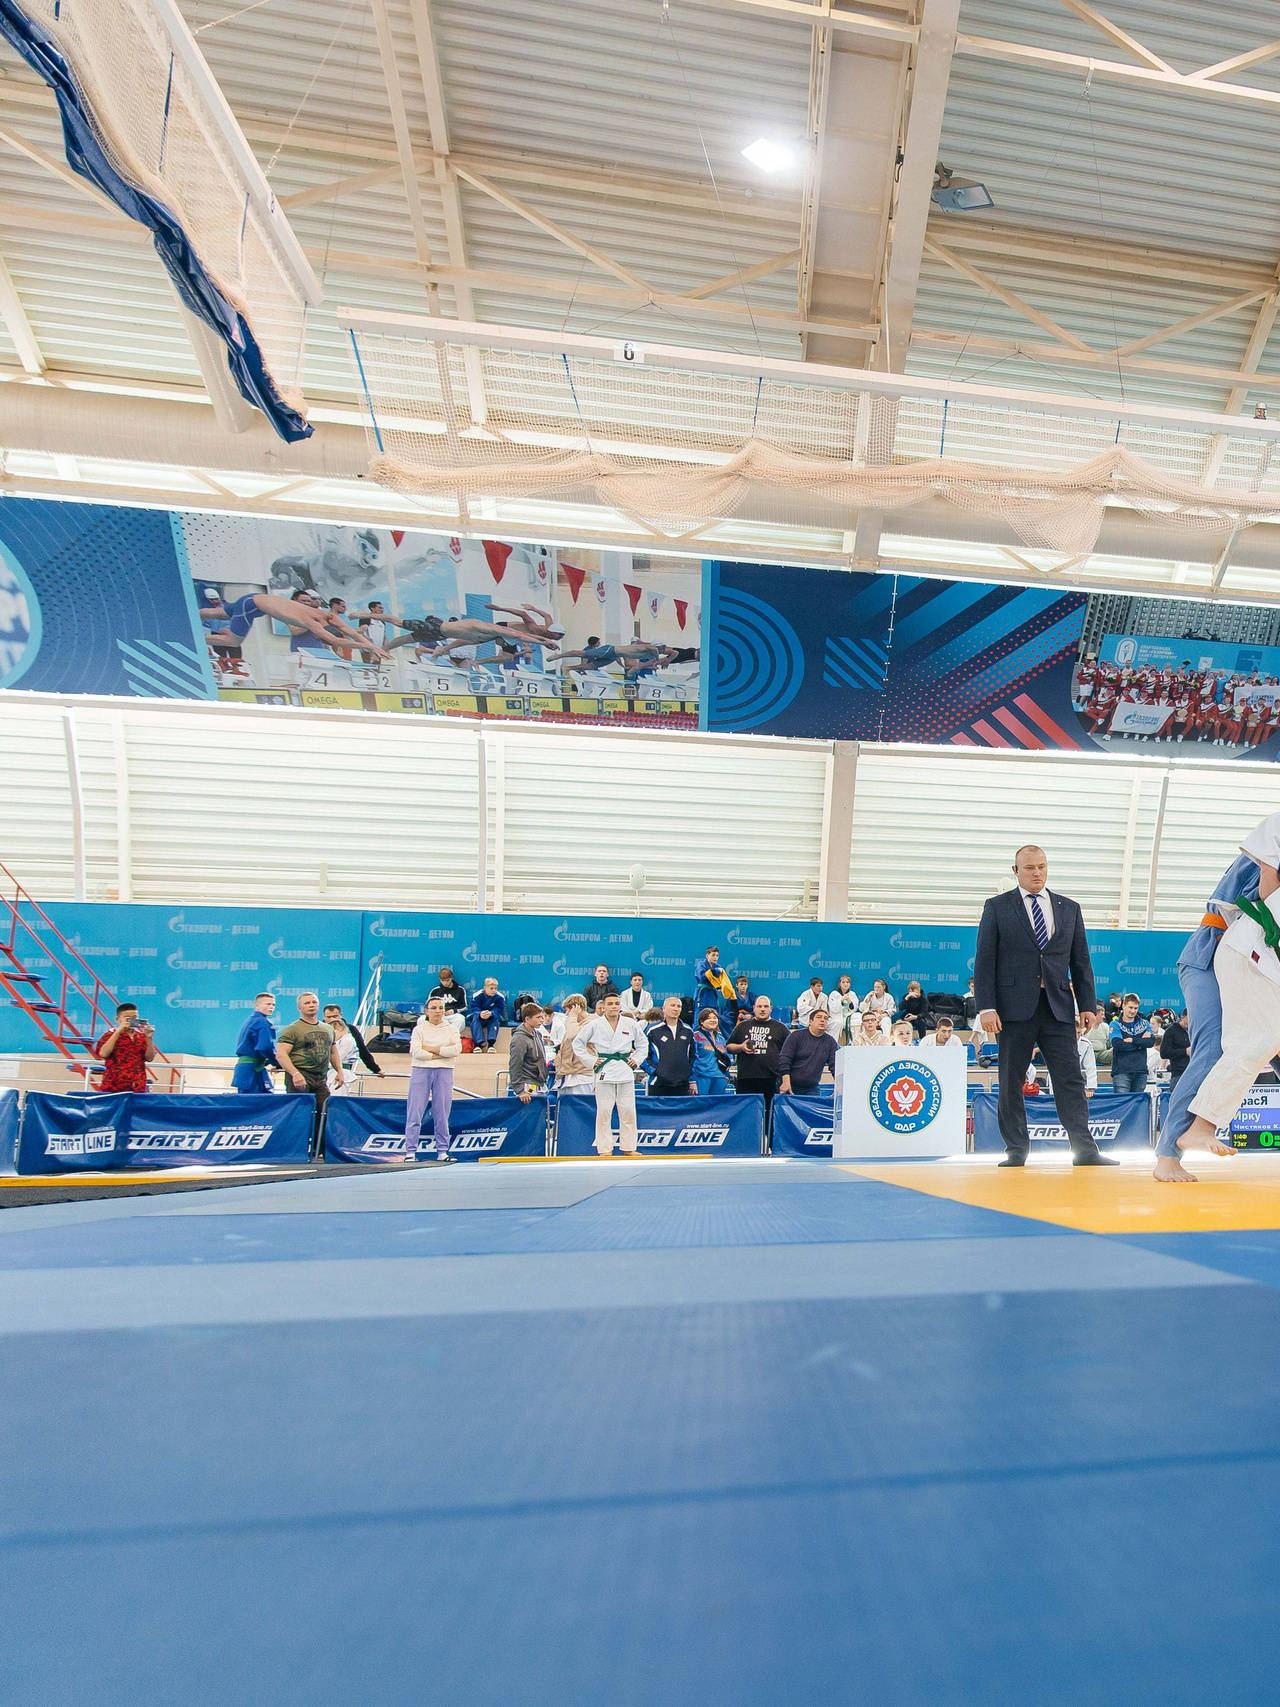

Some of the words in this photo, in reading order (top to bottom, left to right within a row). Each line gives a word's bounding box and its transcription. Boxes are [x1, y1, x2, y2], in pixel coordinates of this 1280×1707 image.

[314, 673, 328, 687] 4
[382, 676, 390, 688] 2
[437, 678, 449, 691] 5
[527, 682, 538, 694] 6
[598, 687, 607, 696] 7
[652, 688, 661, 698] 8
[307, 696, 340, 705] OMEGA
[437, 699, 460, 707] OMEGA
[384, 929, 420, 937] ГАЗПРОМ
[428, 930, 454, 939] ДЕТЯМ
[568, 933, 600, 942] ГАЗПРОМ
[609, 934, 633, 943] ДЕТЯМ
[739, 938, 771, 946] ГАЗПРОМ
[779, 938, 801, 947] ДЕТЯМ
[901, 941, 932, 949] ГАЗПРОМ
[939, 942, 961, 950] ДЕТЯМ
[477, 954, 511, 963] ГАЗПРОМ
[519, 955, 544, 964] ДЕТЯМ
[654, 957, 686, 966] ГАЗПРОМ
[383, 964, 419, 973] ГАЗПРОМ
[820, 961, 851, 969] ГАЗПРОМ
[859, 962, 881, 970] ДЕТЯМ
[567, 967, 595, 976] ГАЗПРО
[777, 971, 800, 980] ДЕТЯМ
[900, 973, 930, 981] ГАЗПРОМ
[937, 974, 959, 982] ДЕТЯМ
[749, 1026, 770, 1034] JUDO
[755, 1041, 768, 1049] PAN
[871, 1065, 895, 1118] ФЕДЕРАЦИЯ
[898, 1062, 931, 1078] ДЗЮДО
[930, 1078, 940, 1117] РОССИИ
[1241, 1096, 1268, 1107] расЯ
[894, 1122, 916, 1131] ФДР
[1027, 1127, 1067, 1137] TART
[1089, 1126, 1116, 1137] INE
[213, 1133, 261, 1146] LINE
[368, 1137, 437, 1149] STR
[455, 1135, 500, 1149] LINE
[680, 1131, 721, 1143] LINE
[50, 1138, 81, 1151] START
[87, 1134, 112, 1149] LINE
